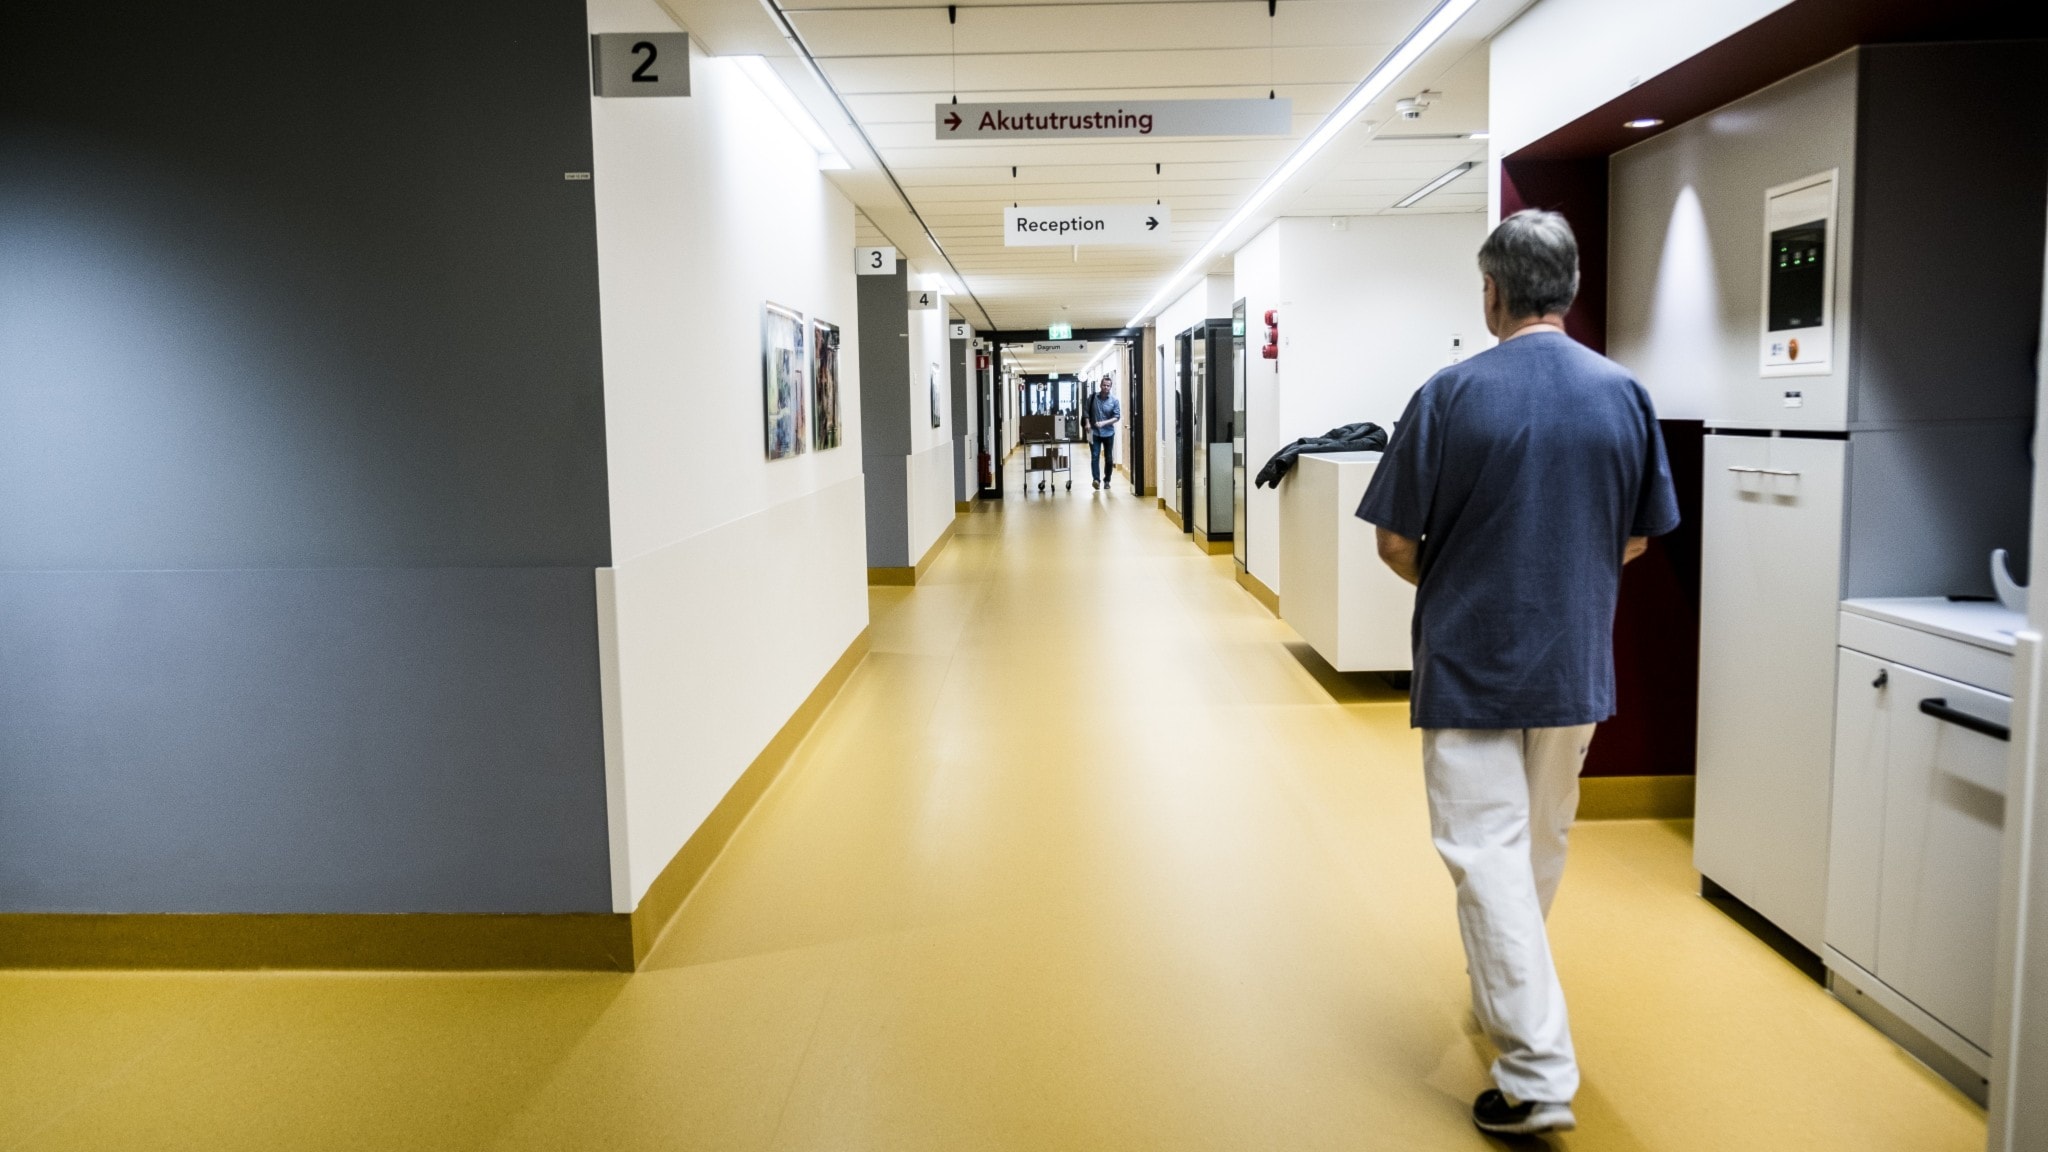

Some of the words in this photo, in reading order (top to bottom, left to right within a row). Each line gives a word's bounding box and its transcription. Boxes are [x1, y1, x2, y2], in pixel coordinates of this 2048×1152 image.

[631, 41, 658, 83] 2
[978, 109, 1153, 134] Akututrustning
[1017, 217, 1105, 235] Reception
[871, 250, 883, 269] 3
[919, 293, 929, 306] 4
[957, 326, 964, 336] 5
[972, 339, 979, 348] 6
